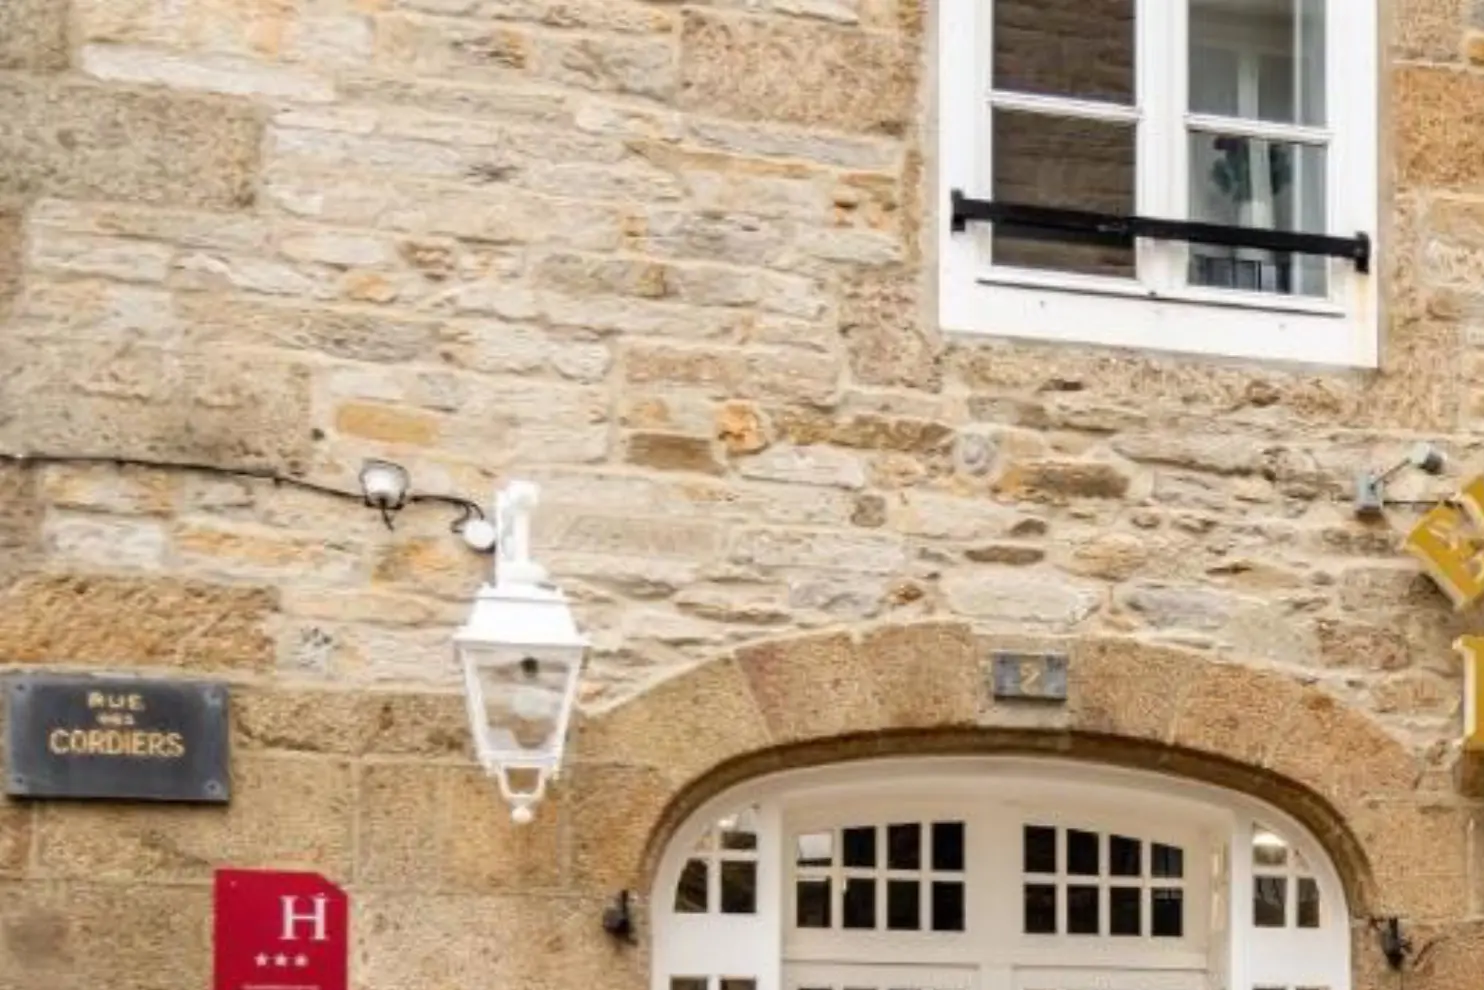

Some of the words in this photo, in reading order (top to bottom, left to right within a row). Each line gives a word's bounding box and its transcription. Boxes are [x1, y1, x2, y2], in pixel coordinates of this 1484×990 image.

[87, 691, 146, 711] RUE
[49, 728, 186, 758] CORDIERS
[277, 893, 330, 941] H
